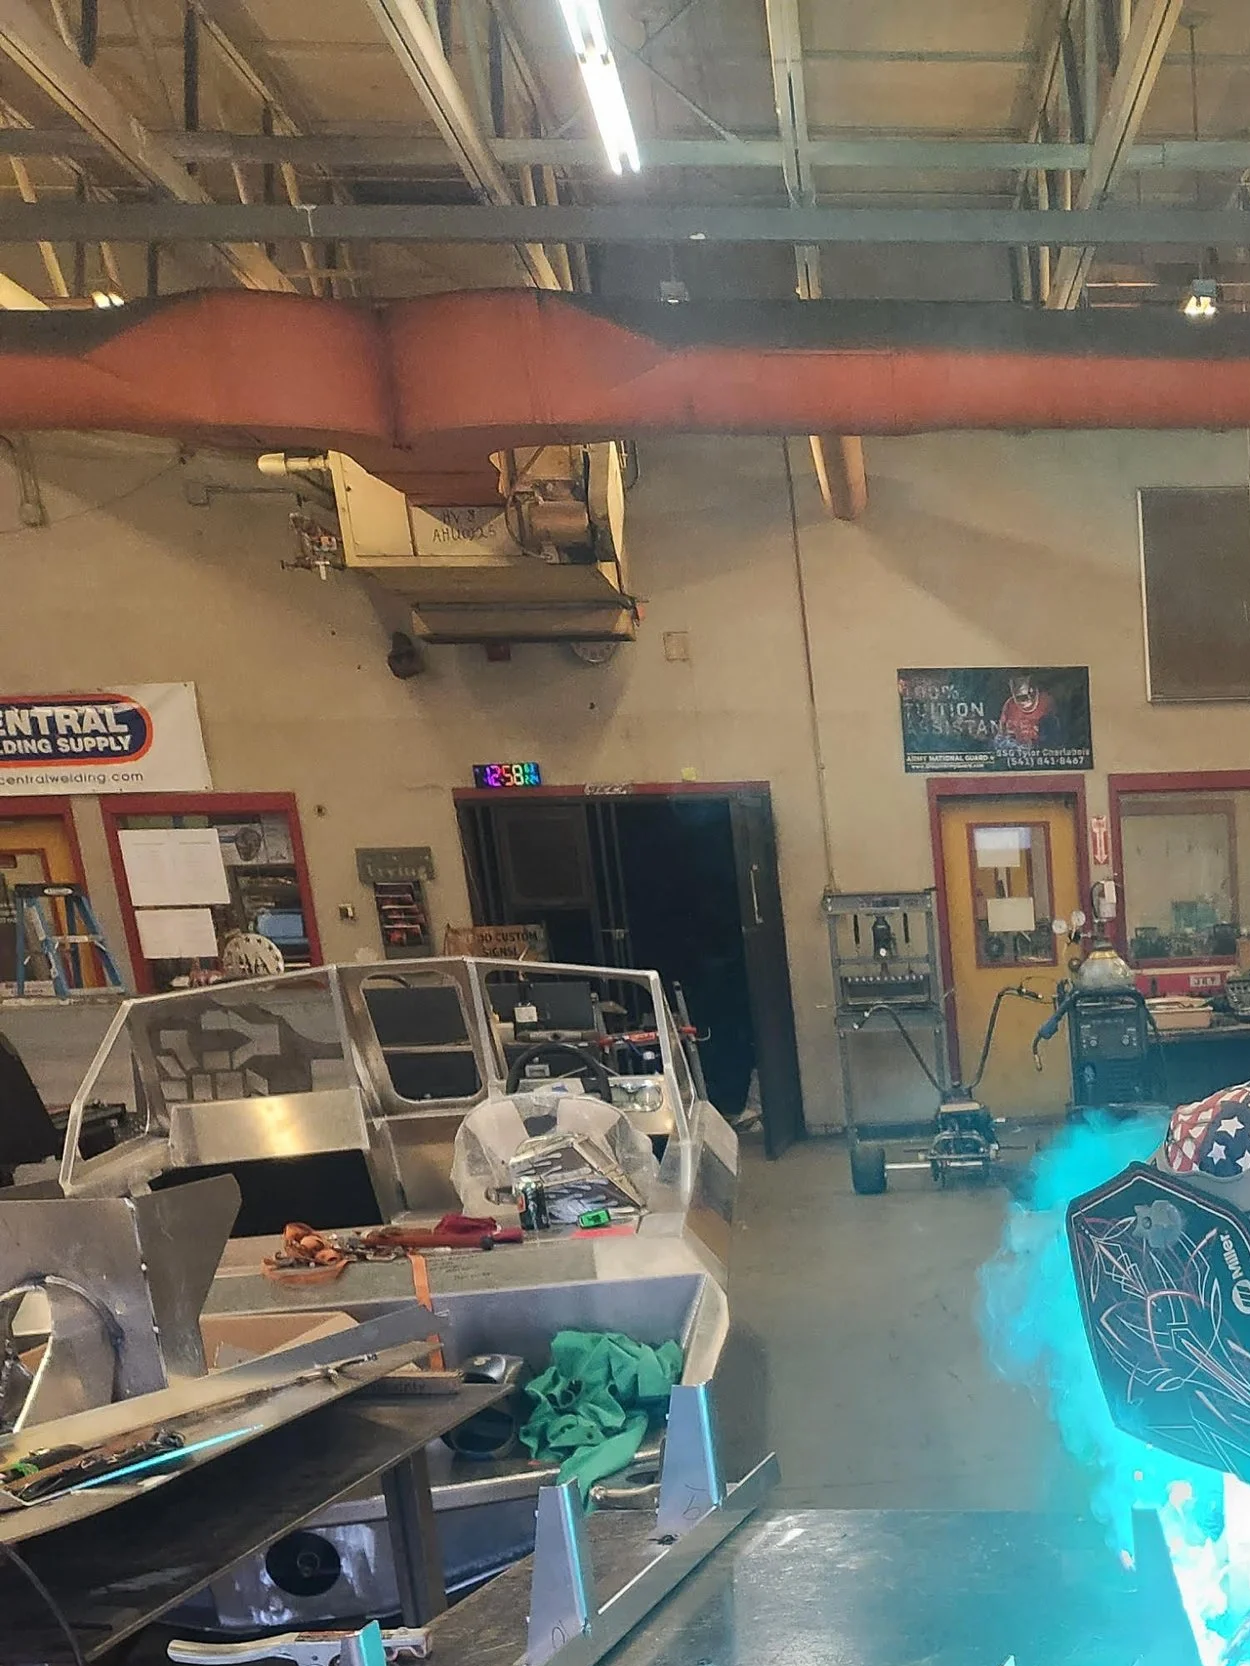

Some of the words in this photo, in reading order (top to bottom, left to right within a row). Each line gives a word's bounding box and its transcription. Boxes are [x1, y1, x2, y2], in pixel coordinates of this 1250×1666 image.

[903, 701, 984, 718] TUITION
[0, 739, 53, 755] DING
[58, 734, 132, 753] SUPPLY
[496, 931, 538, 943] CUSTOM
[1220, 1233, 1244, 1280] Miller
